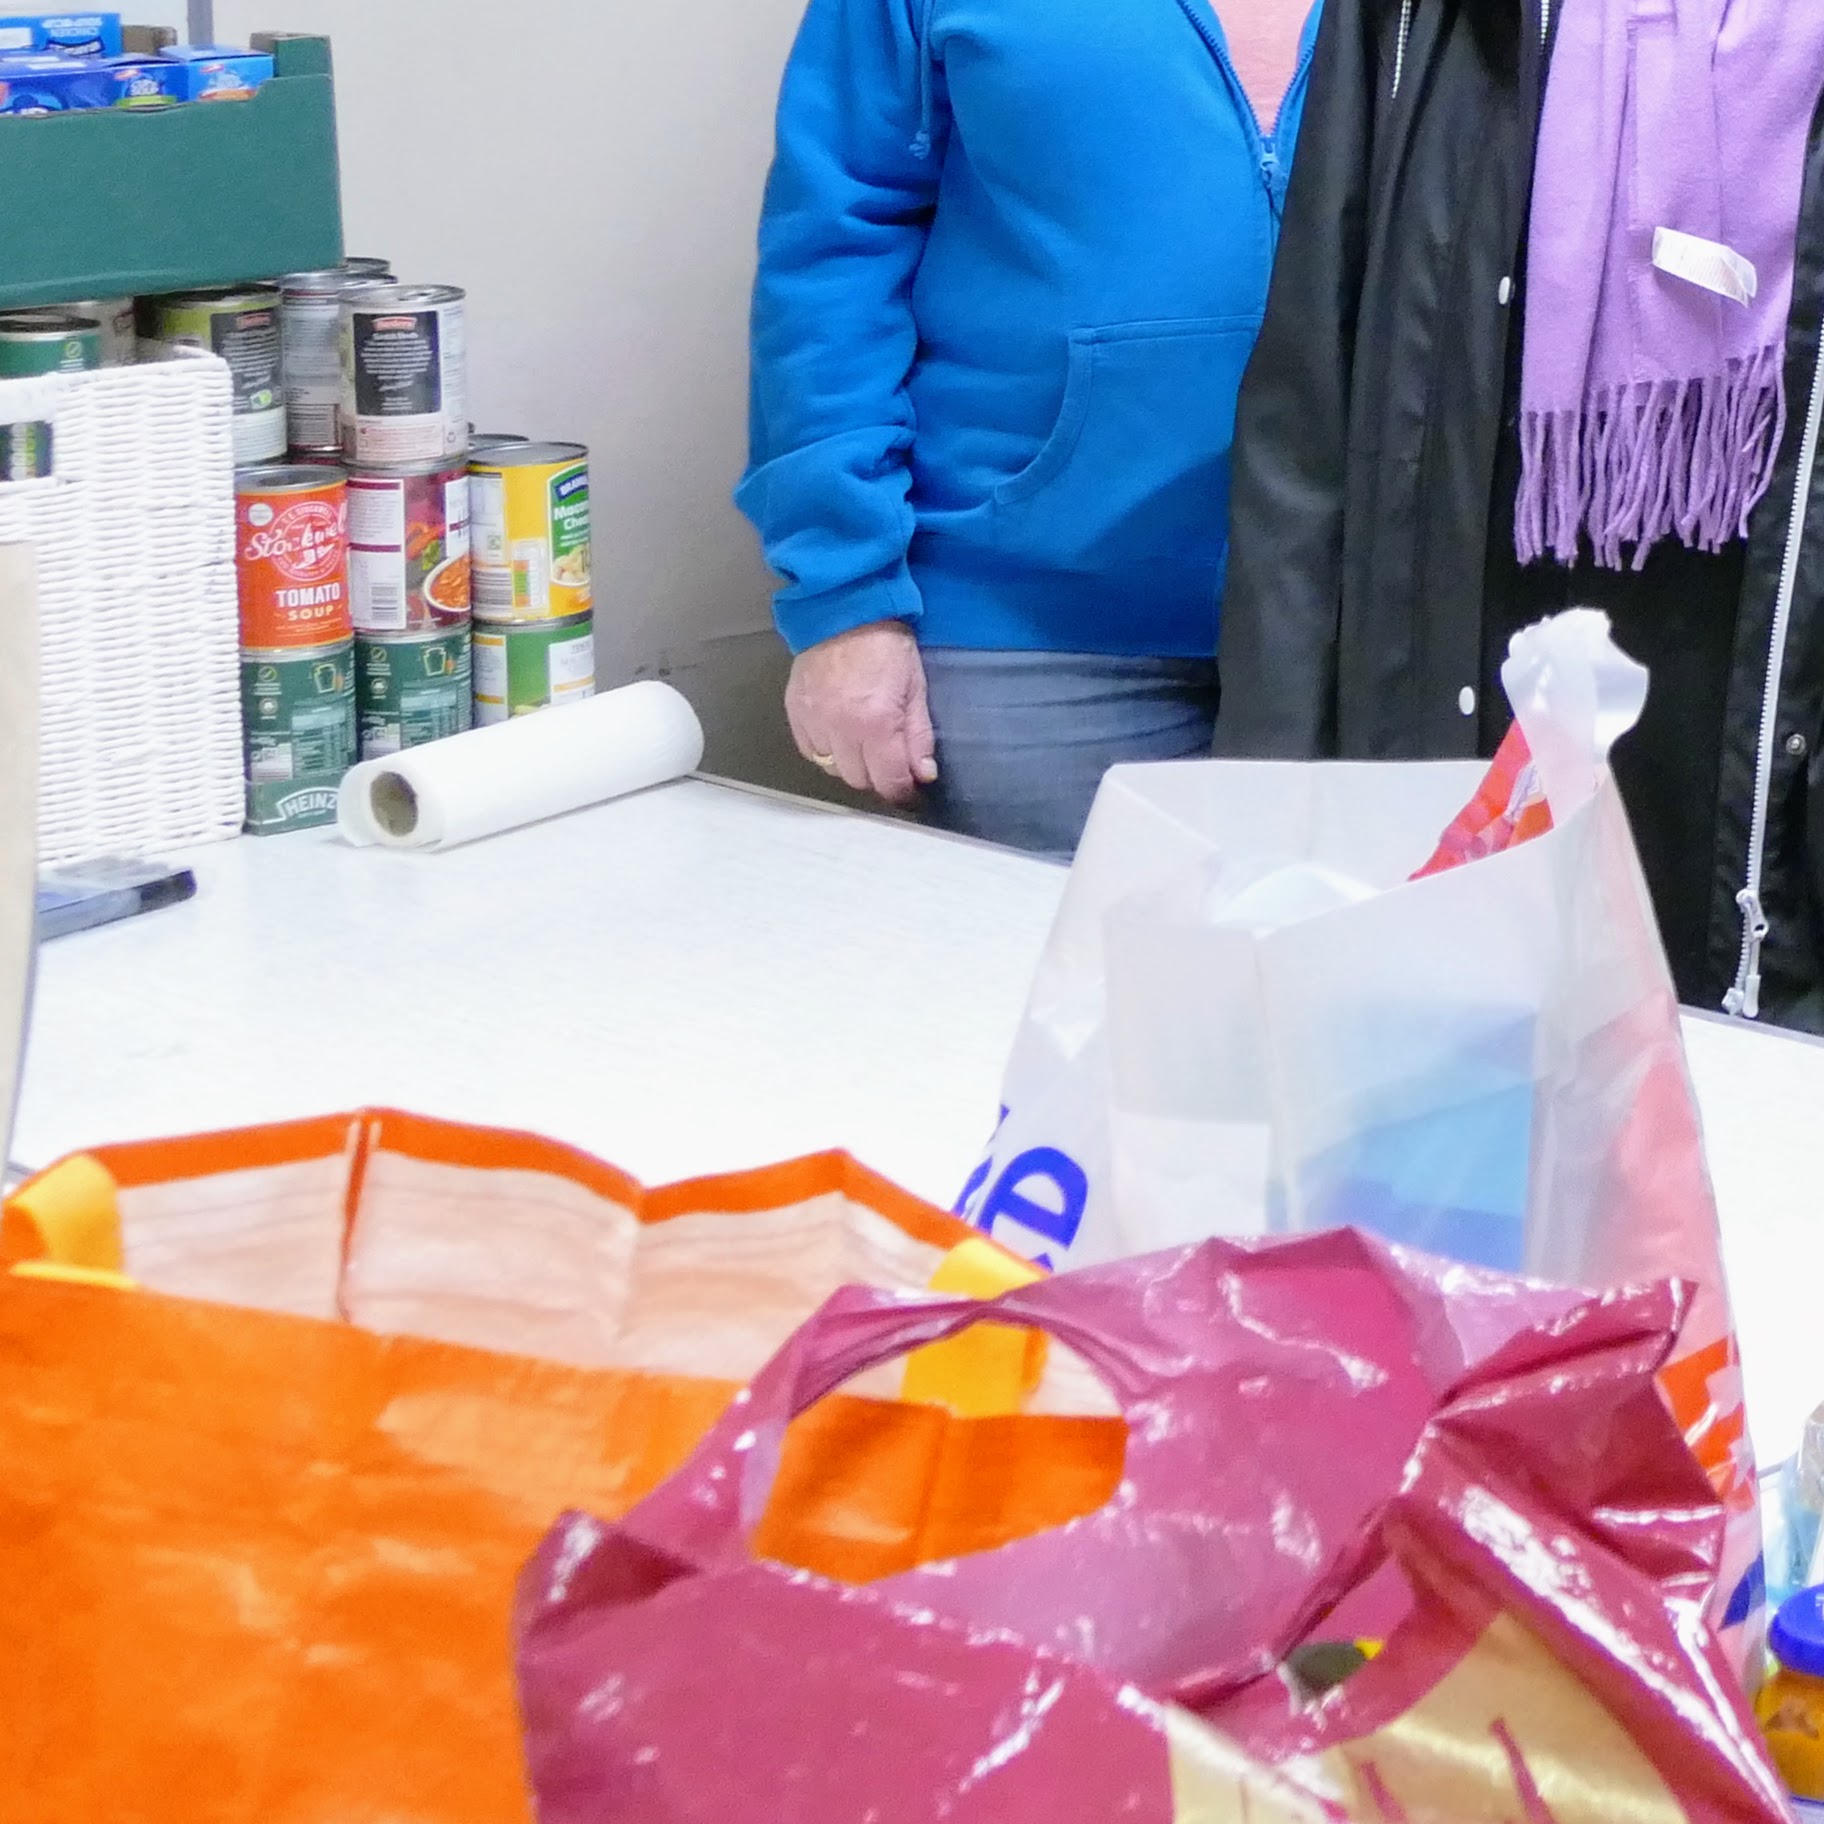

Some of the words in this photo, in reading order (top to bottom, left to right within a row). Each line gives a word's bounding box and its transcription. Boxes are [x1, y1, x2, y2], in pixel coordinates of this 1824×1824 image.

[275, 582, 341, 608] TOMATO
[287, 605, 334, 621] SOUP
[286, 795, 337, 818] HEINZ
